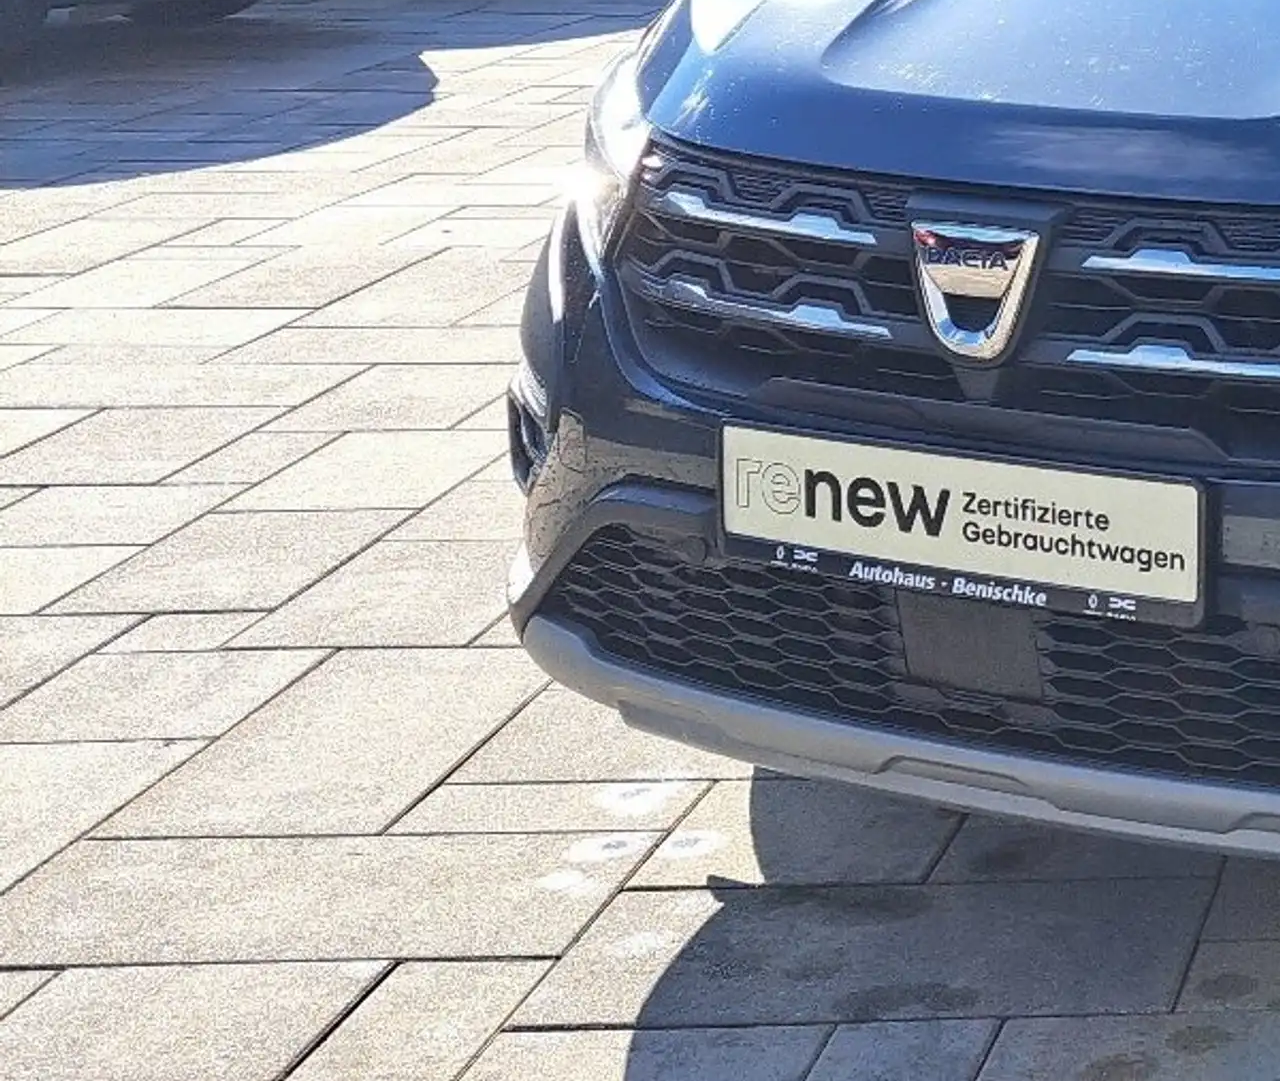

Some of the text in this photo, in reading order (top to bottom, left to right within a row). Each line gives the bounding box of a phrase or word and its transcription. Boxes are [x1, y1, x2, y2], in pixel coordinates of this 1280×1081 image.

[927, 246, 1008, 271] DACIA
[736, 457, 950, 538] renew
[962, 491, 1110, 531] Zertifizierte
[962, 521, 1186, 573] Gebrauchtwagen
[849, 561, 936, 590] Autohaus
[952, 577, 1047, 607] Benischke
